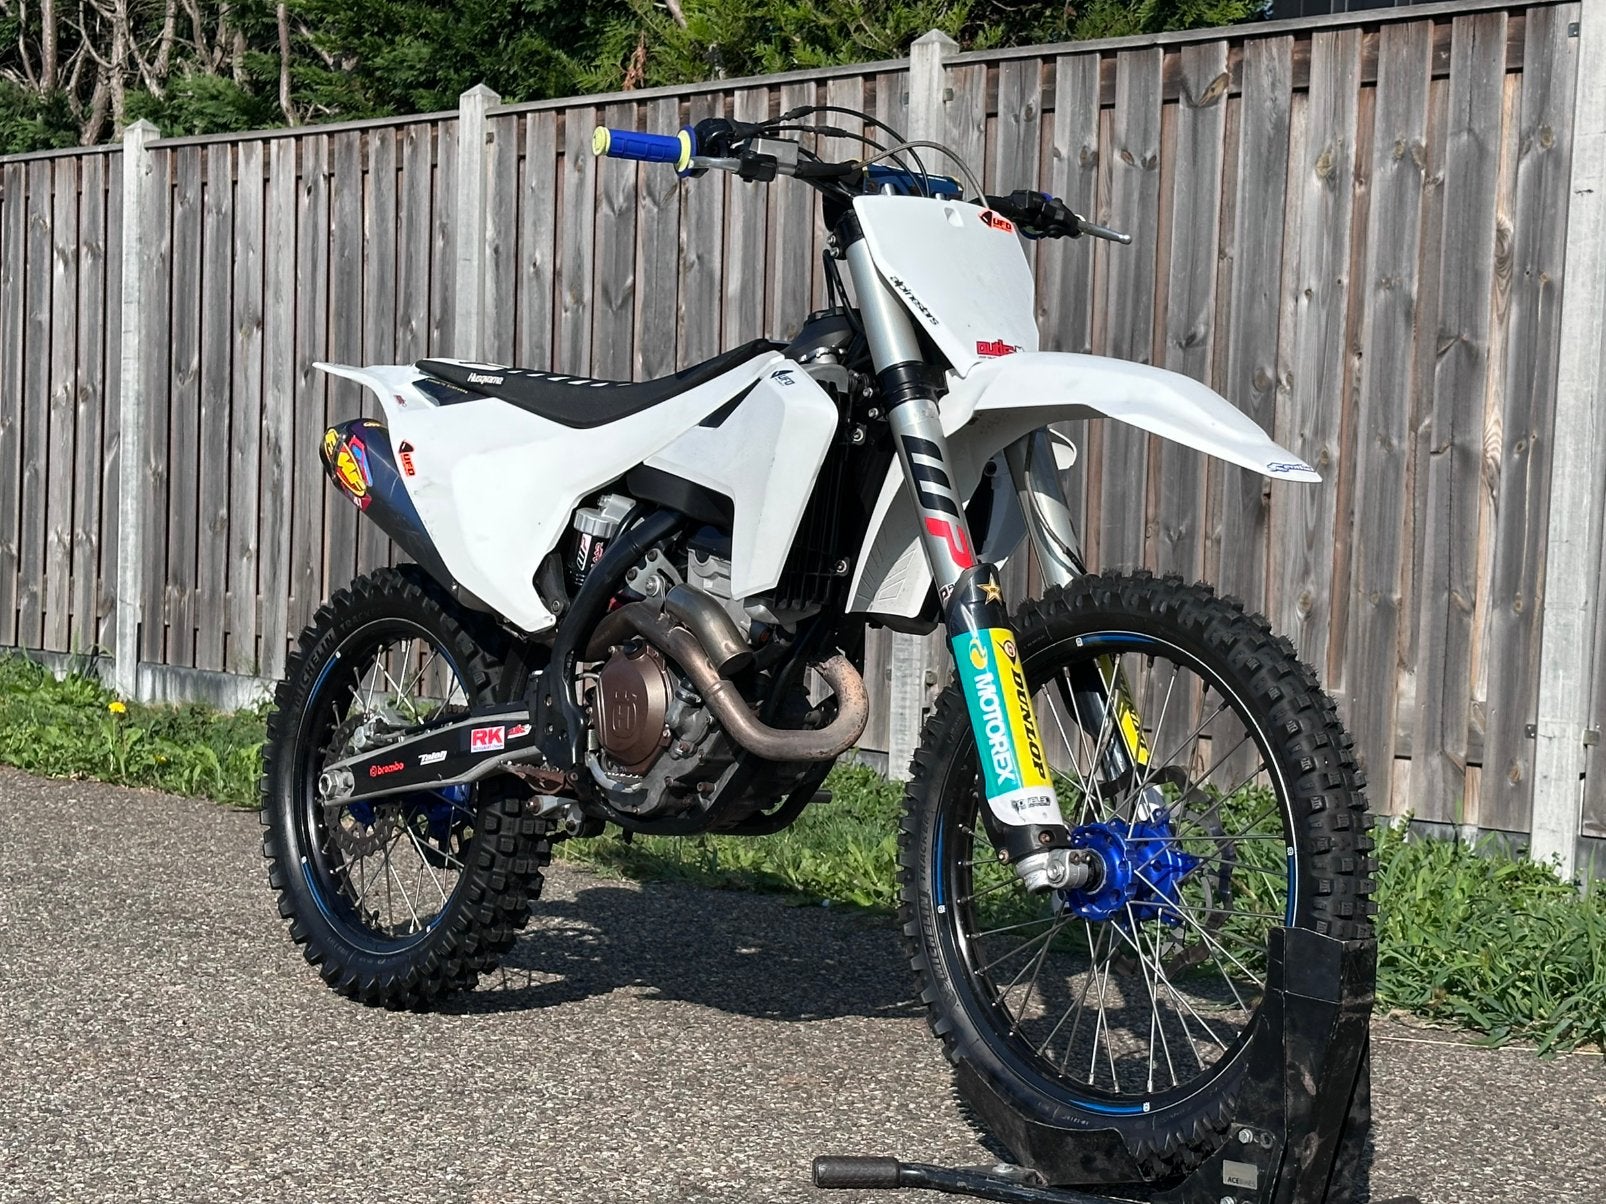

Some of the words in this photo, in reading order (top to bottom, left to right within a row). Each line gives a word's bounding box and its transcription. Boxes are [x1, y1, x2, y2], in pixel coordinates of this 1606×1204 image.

[992, 217, 1012, 231] UFO
[467, 372, 504, 385] Husqvarna
[403, 454, 415, 476] UFO
[973, 671, 1016, 786] MOTOREX
[1011, 666, 1047, 780] DUNLOP
[471, 728, 503, 746] RK
[376, 762, 405, 776] brembo
